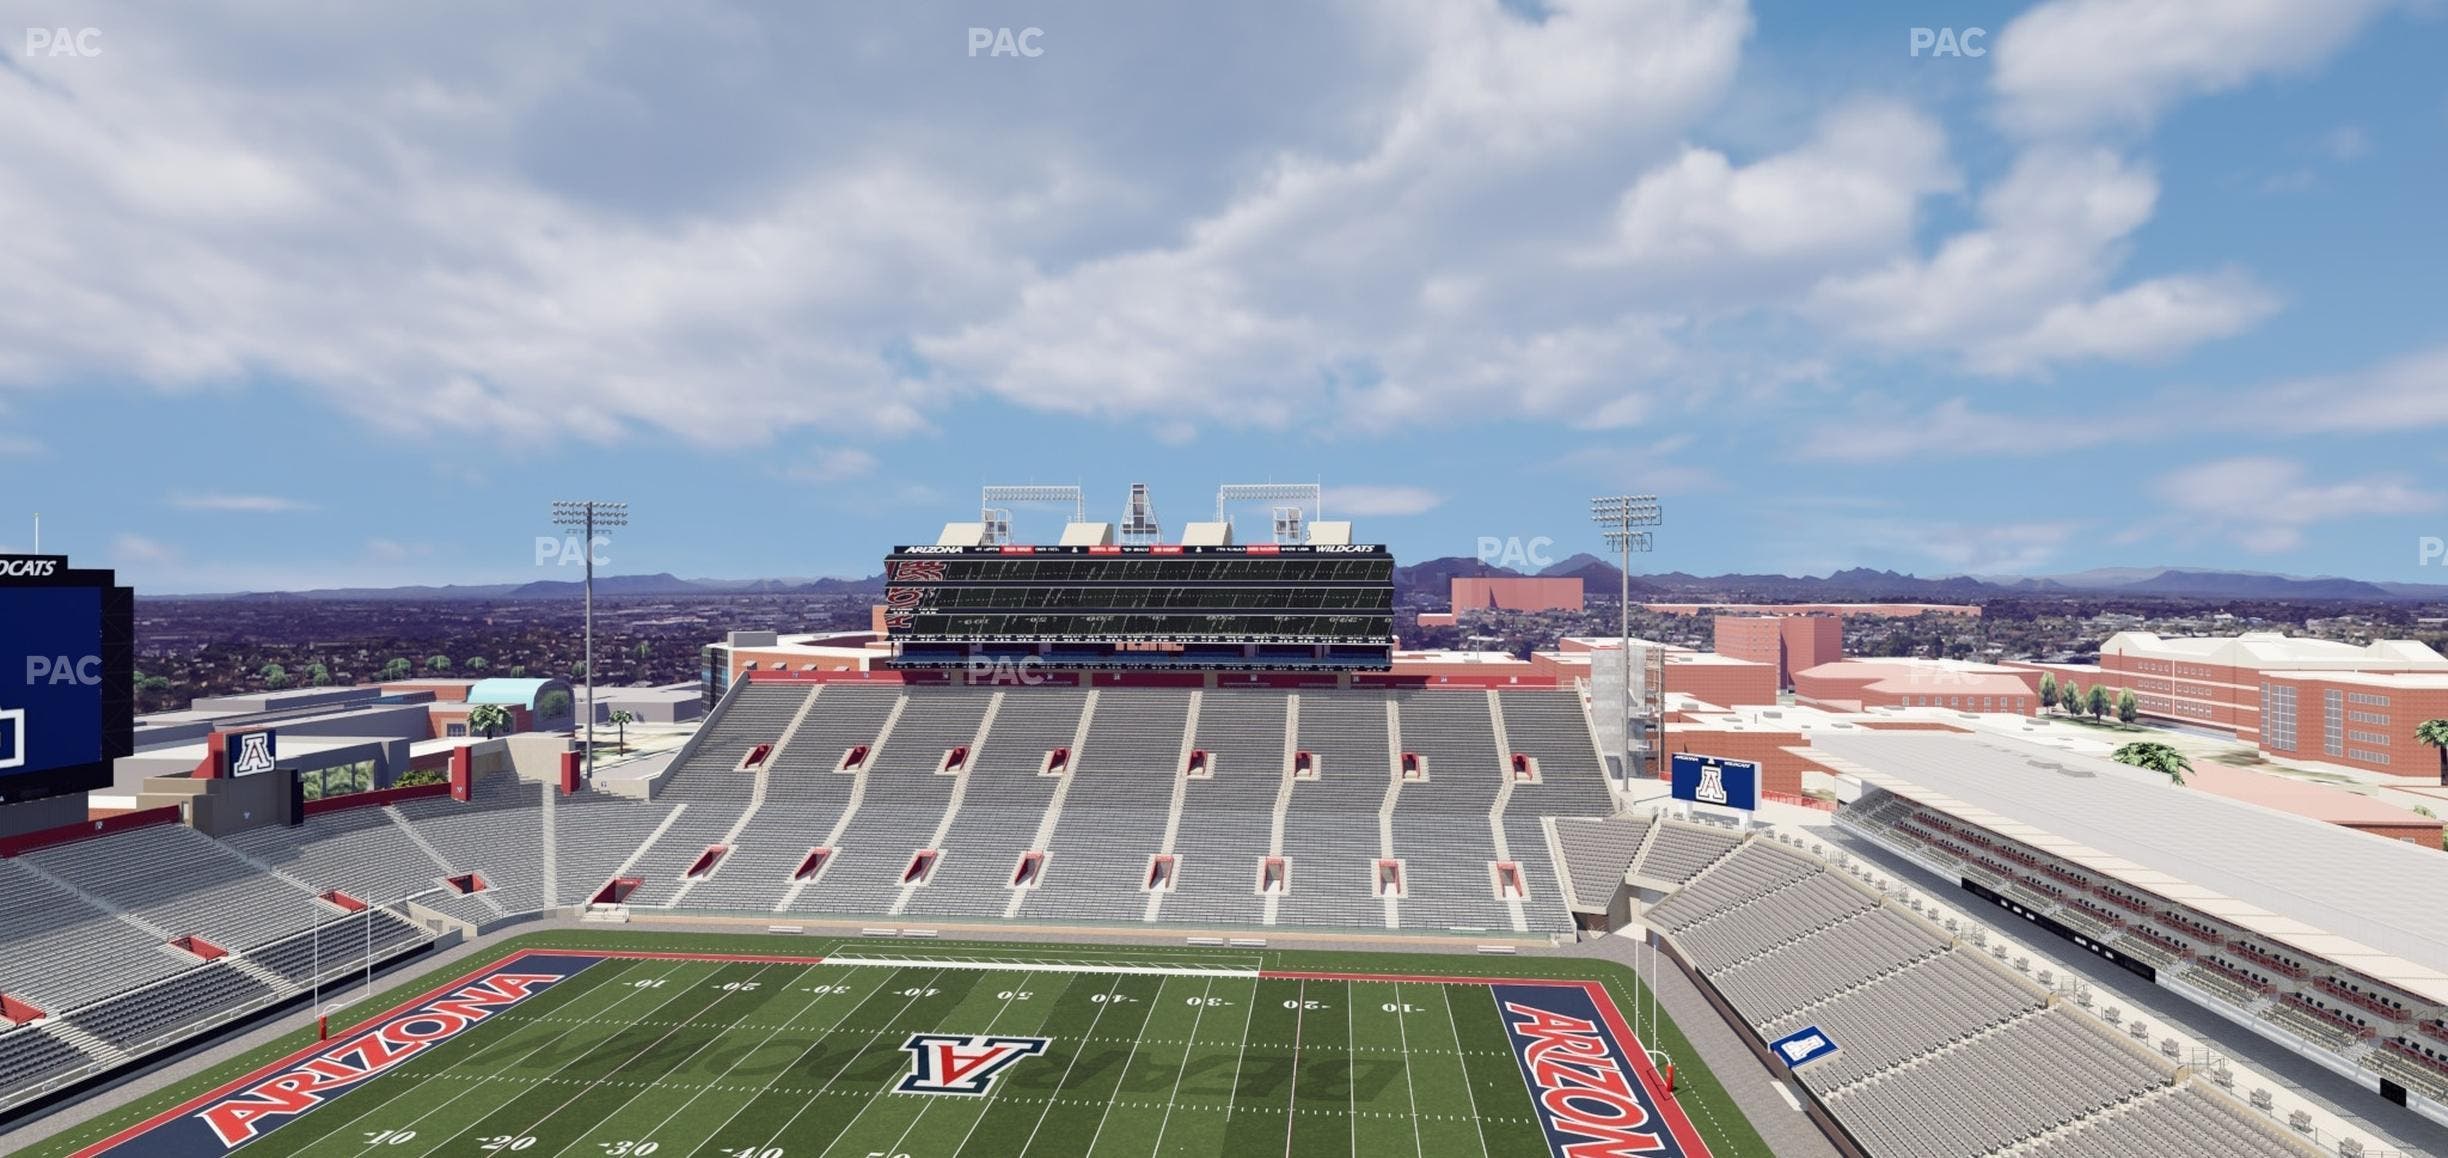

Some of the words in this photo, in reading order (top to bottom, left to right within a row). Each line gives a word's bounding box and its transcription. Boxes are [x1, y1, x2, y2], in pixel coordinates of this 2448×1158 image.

[904, 546, 963, 554] ARIZONA
[1316, 545, 1375, 553] WILDCATS
[234, 732, 274, 777] A
[1696, 765, 1727, 804] A
[194, 973, 565, 1148] ARIZONA
[889, 1033, 1053, 1097] A
